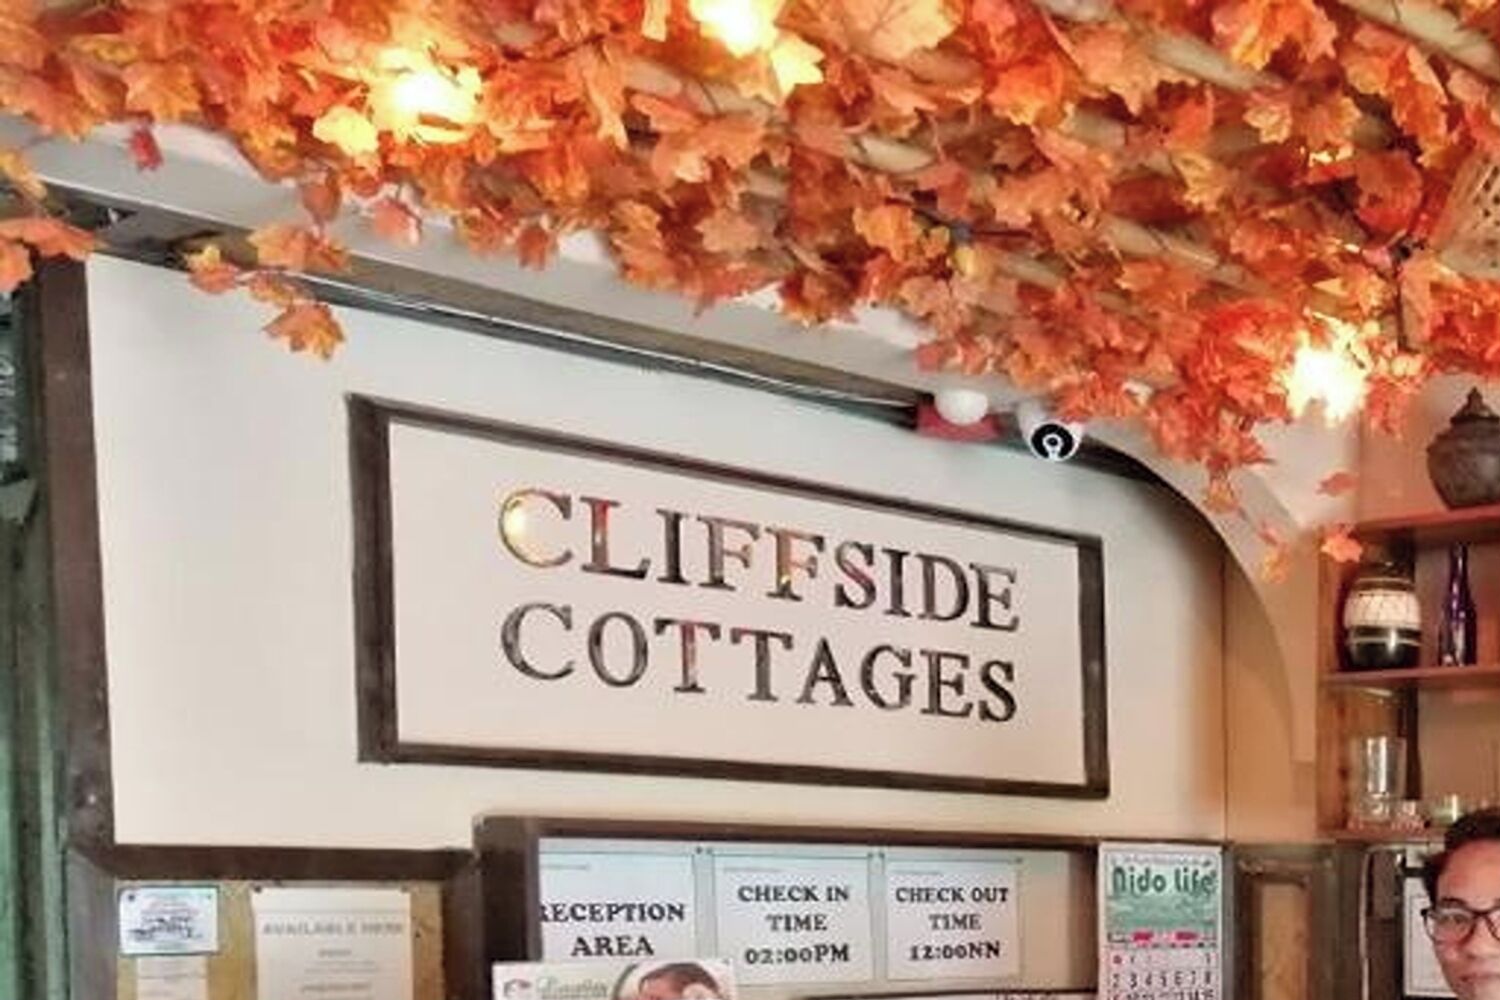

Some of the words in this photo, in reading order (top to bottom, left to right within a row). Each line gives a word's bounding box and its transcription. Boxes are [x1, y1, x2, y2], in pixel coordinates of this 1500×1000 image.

[499, 488, 1020, 633] CLIFFSIDE
[500, 601, 1017, 722] COTTAGES
[737, 884, 821, 902] CHECK
[826, 885, 849, 902] IN
[895, 887, 965, 904] CHECK
[971, 886, 1009, 903] OUT
[765, 912, 828, 932] TIME
[928, 913, 982, 931] TIME
[571, 934, 655, 957] AREA
[744, 942, 850, 965] 02:00PM
[909, 939, 1001, 962] 12:00NN
